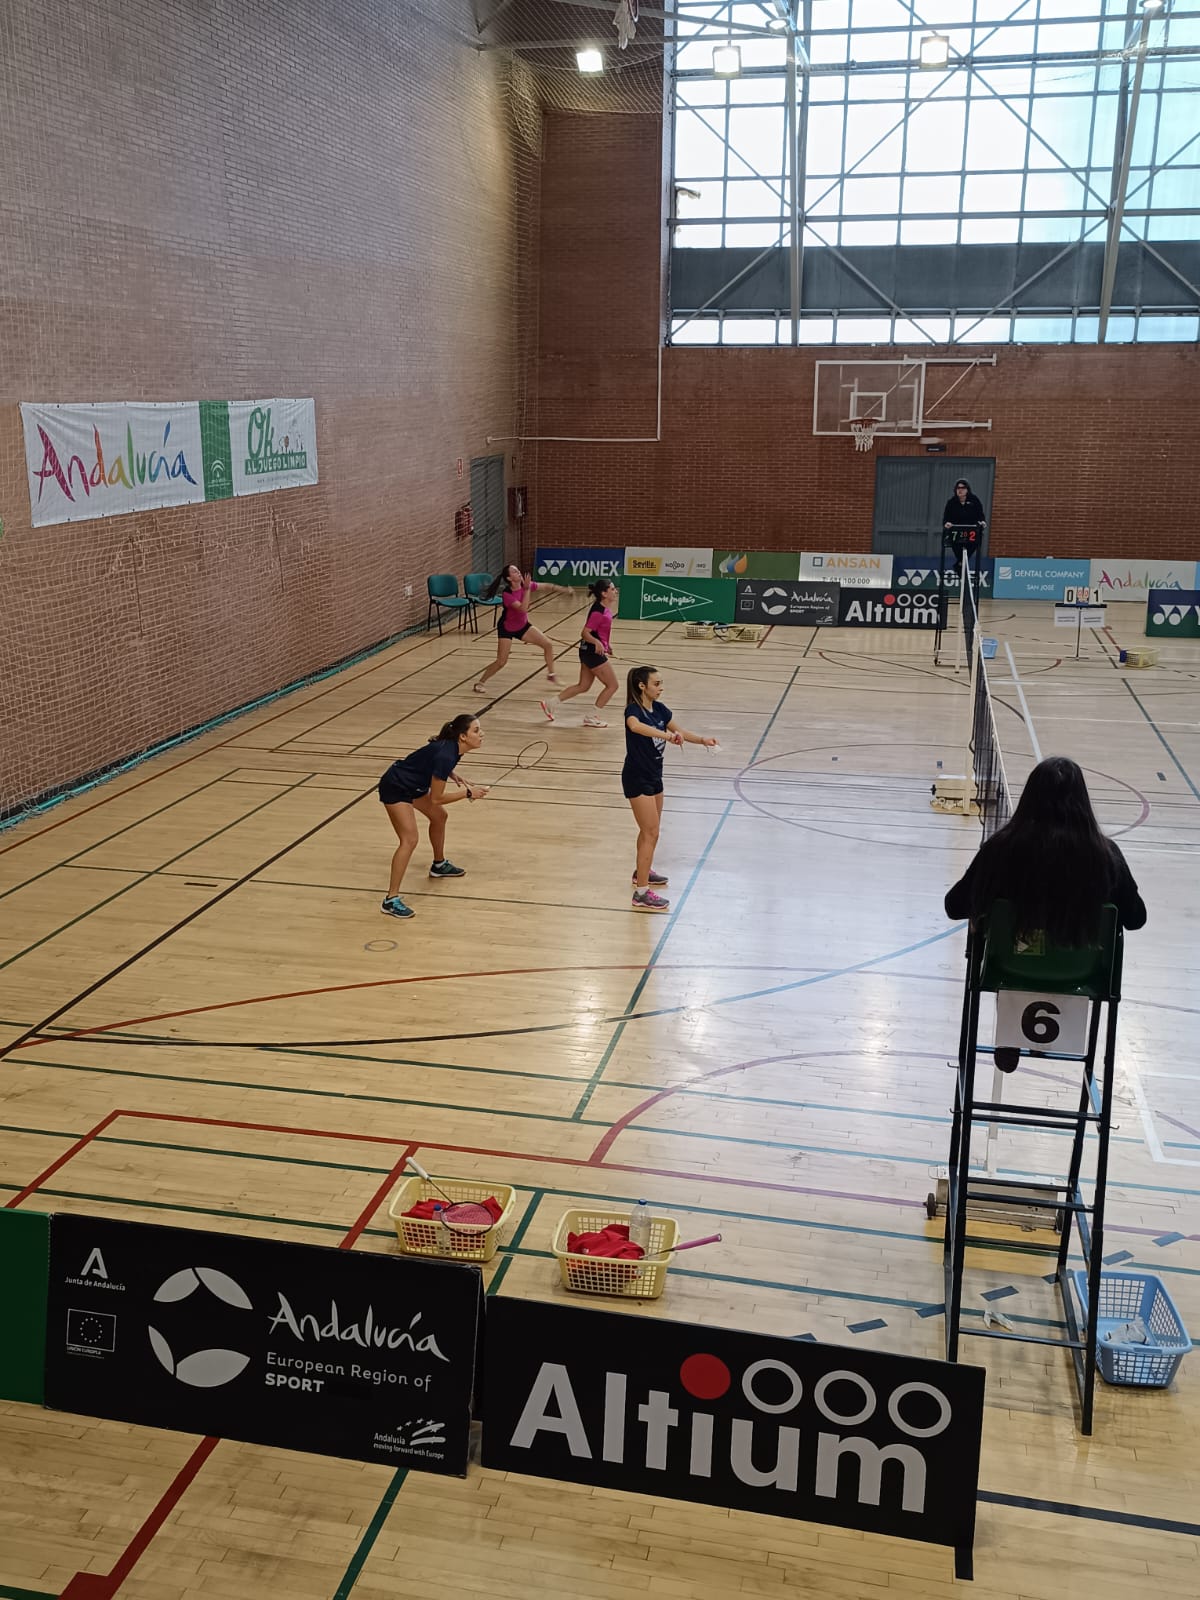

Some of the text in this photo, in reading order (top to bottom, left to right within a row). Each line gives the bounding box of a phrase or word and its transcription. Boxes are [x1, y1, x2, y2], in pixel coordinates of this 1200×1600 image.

[32, 420, 198, 503] Andalucía
[247, 454, 306, 474] AL JUEGO LIMPIO
[952, 531, 958, 541] 7
[969, 530, 976, 541] 2
[570, 560, 620, 577] YONEX
[826, 556, 880, 568] ANSAN
[1014, 569, 1085, 579] DENTAL COMPANY
[1067, 590, 1074, 602] 0
[1094, 590, 1099, 602] 1
[845, 596, 938, 625] Altium
[1021, 1001, 1061, 1044] 6
[65, 1276, 83, 1285] Junta
[93, 1280, 126, 1291] Andalucía
[267, 1291, 450, 1363] Andalucía
[266, 1351, 432, 1393] European Region of
[264, 1372, 325, 1393] SPORT
[374, 1432, 406, 1445] Andalusia
[509, 1356, 927, 1514] Altium
